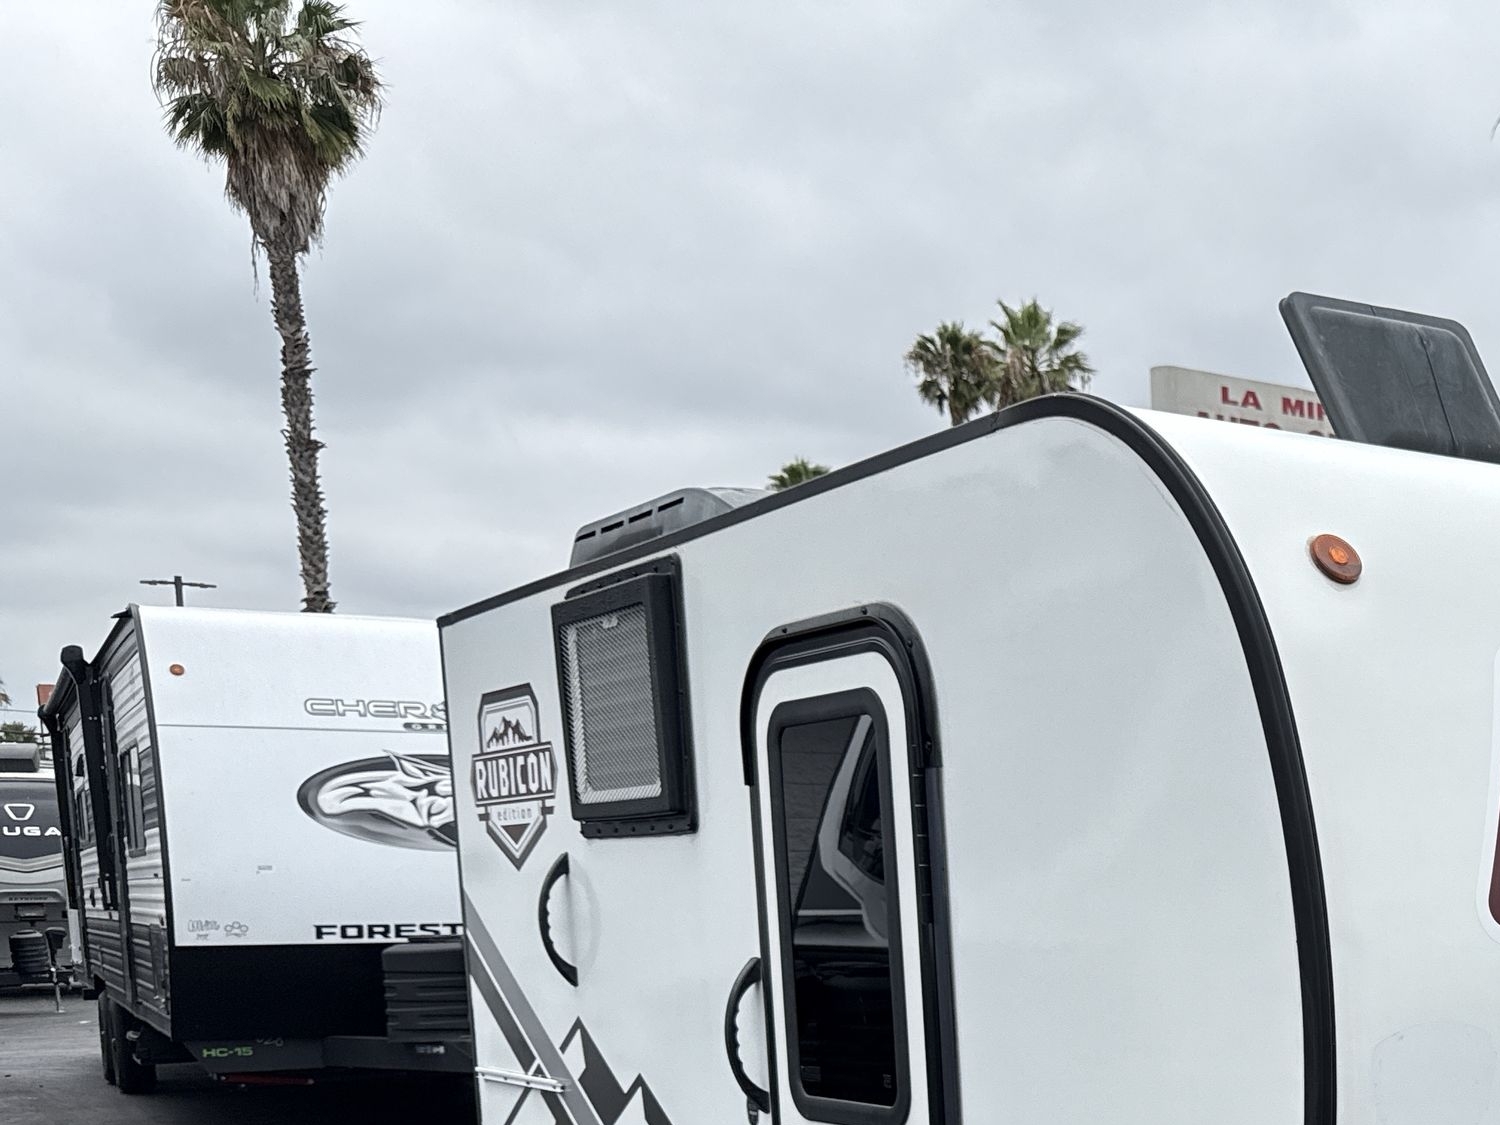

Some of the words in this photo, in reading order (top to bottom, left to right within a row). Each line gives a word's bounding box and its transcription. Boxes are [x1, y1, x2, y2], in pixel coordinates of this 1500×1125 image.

[1220, 385, 1263, 411] LA
[474, 750, 553, 800] RUBICON
[313, 923, 463, 940] FOREST
[202, 1046, 254, 1058] HC-15
